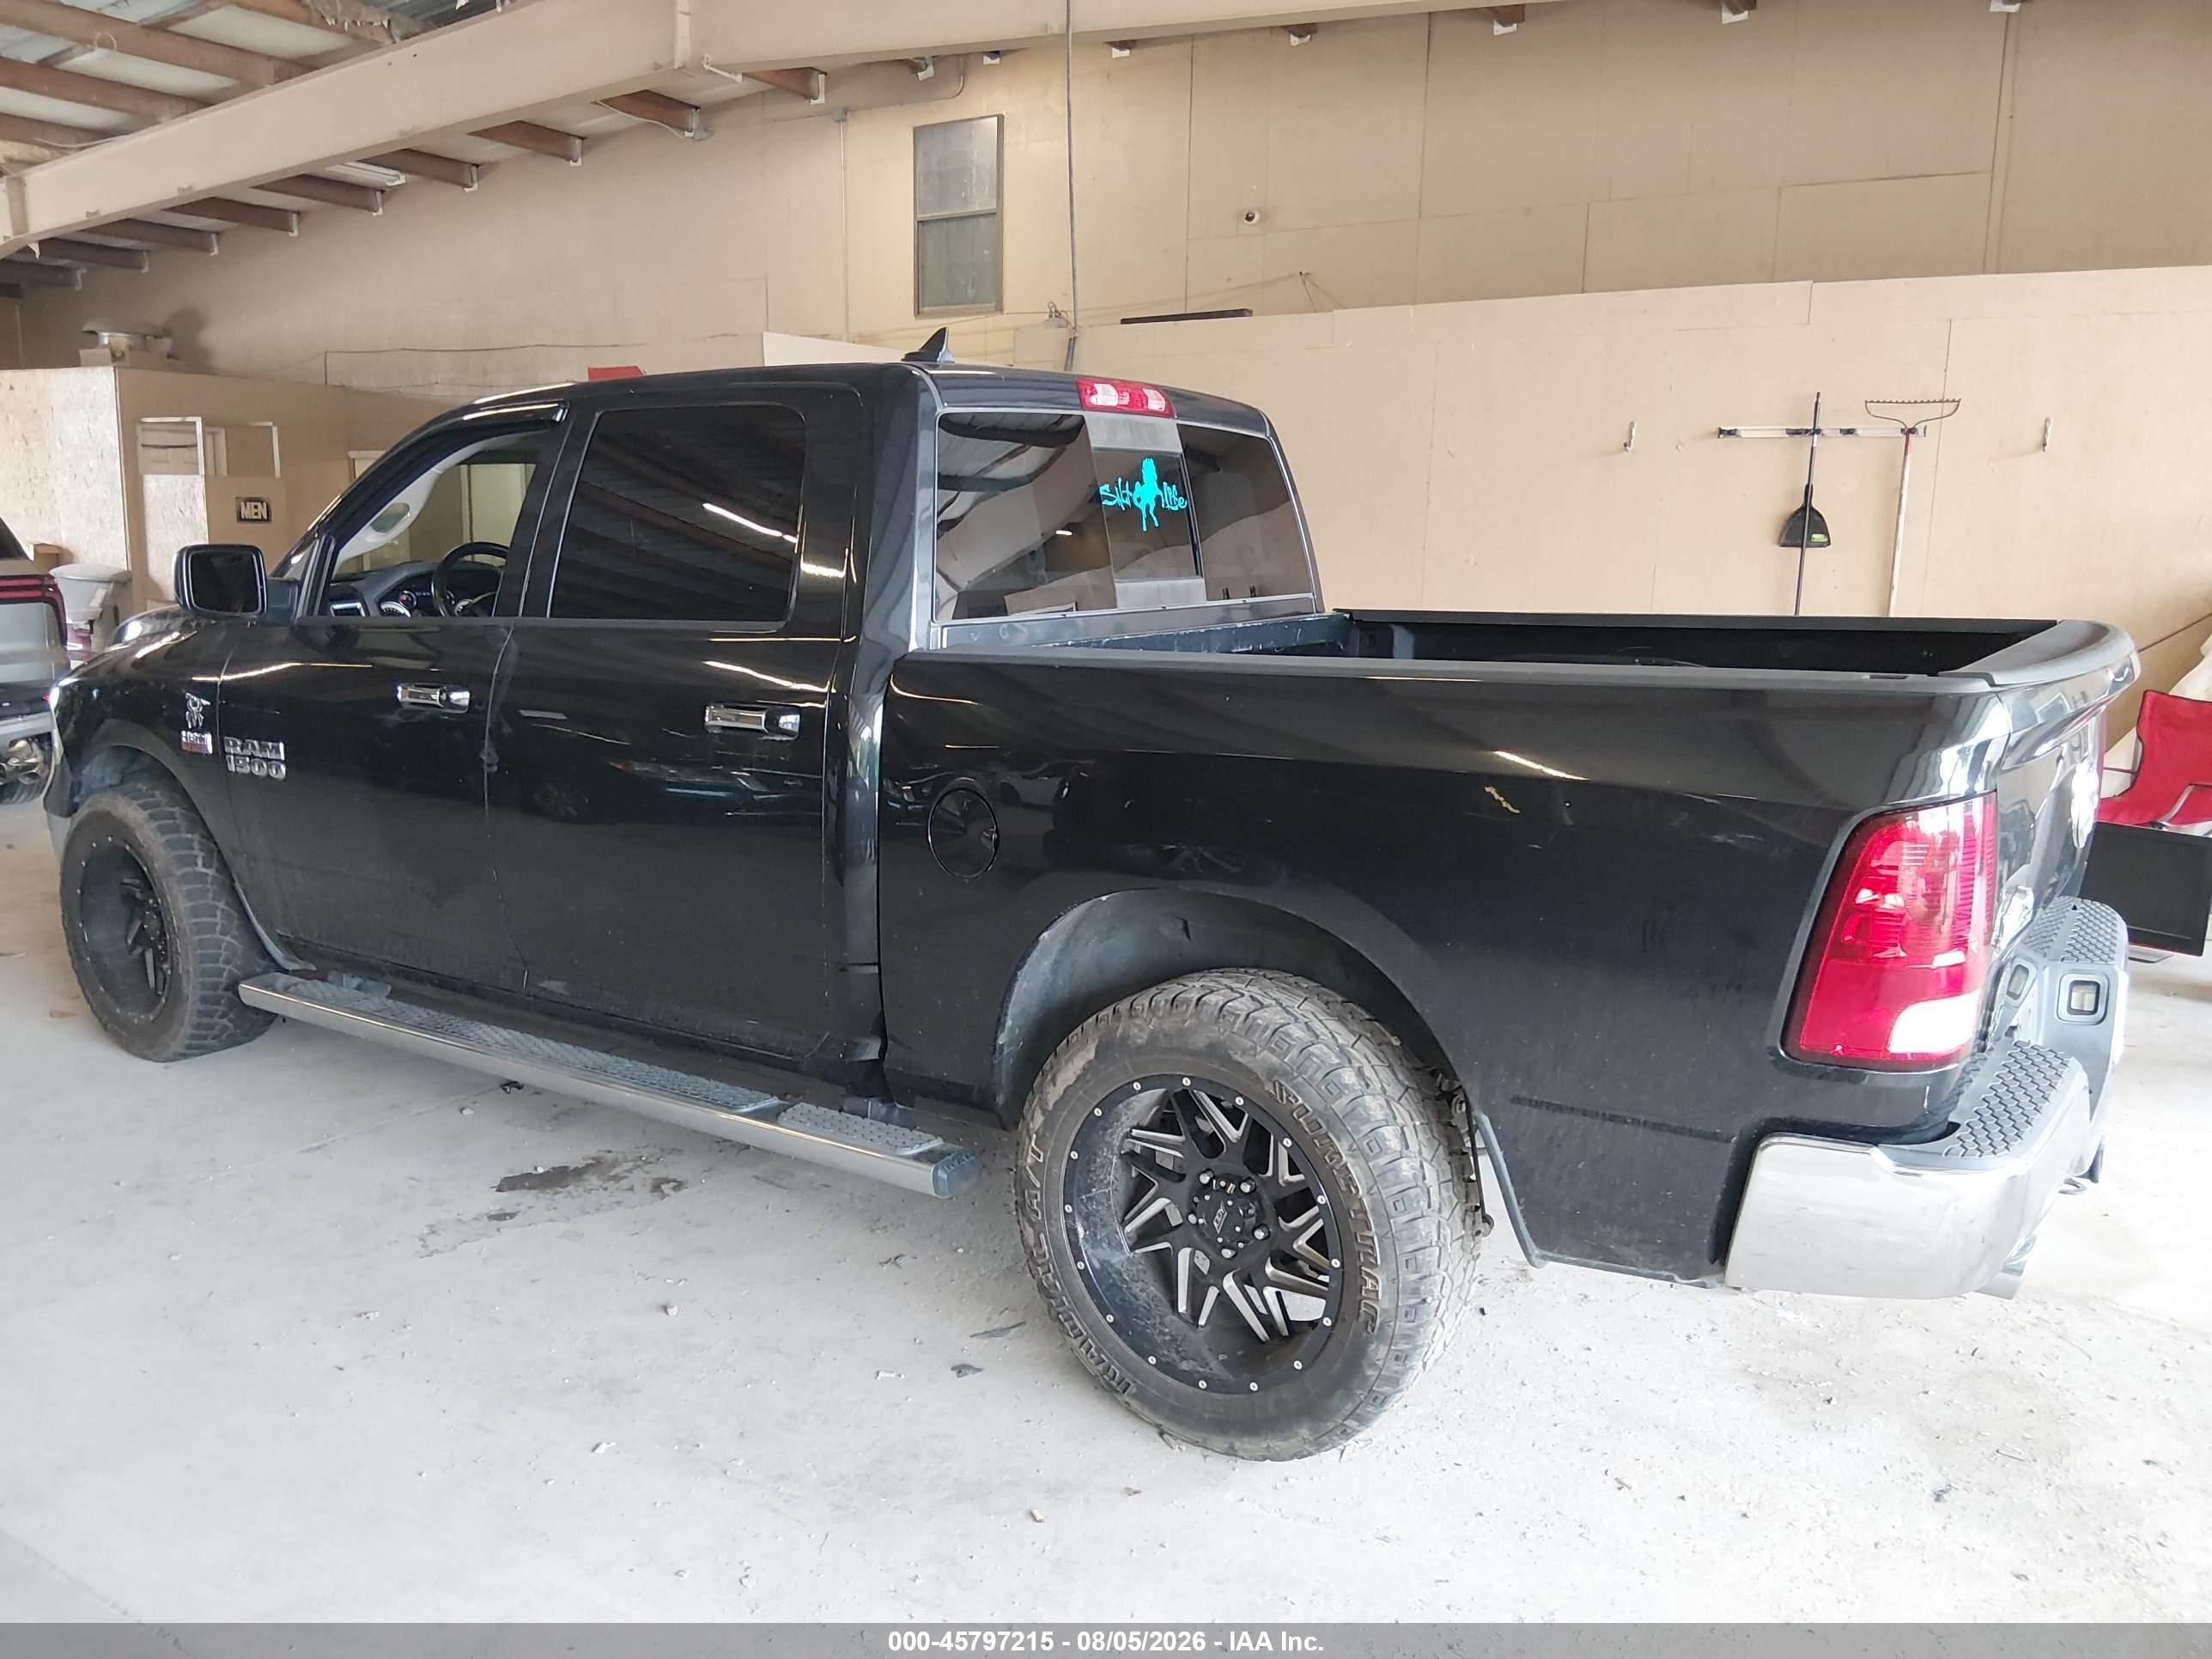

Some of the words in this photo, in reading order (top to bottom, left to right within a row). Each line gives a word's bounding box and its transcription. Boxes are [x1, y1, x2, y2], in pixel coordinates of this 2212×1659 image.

[240, 501, 267, 520] MEN
[224, 736, 285, 761] RAM
[226, 755, 286, 781] 1500
[1030, 1232, 1134, 1395] RADIAL
